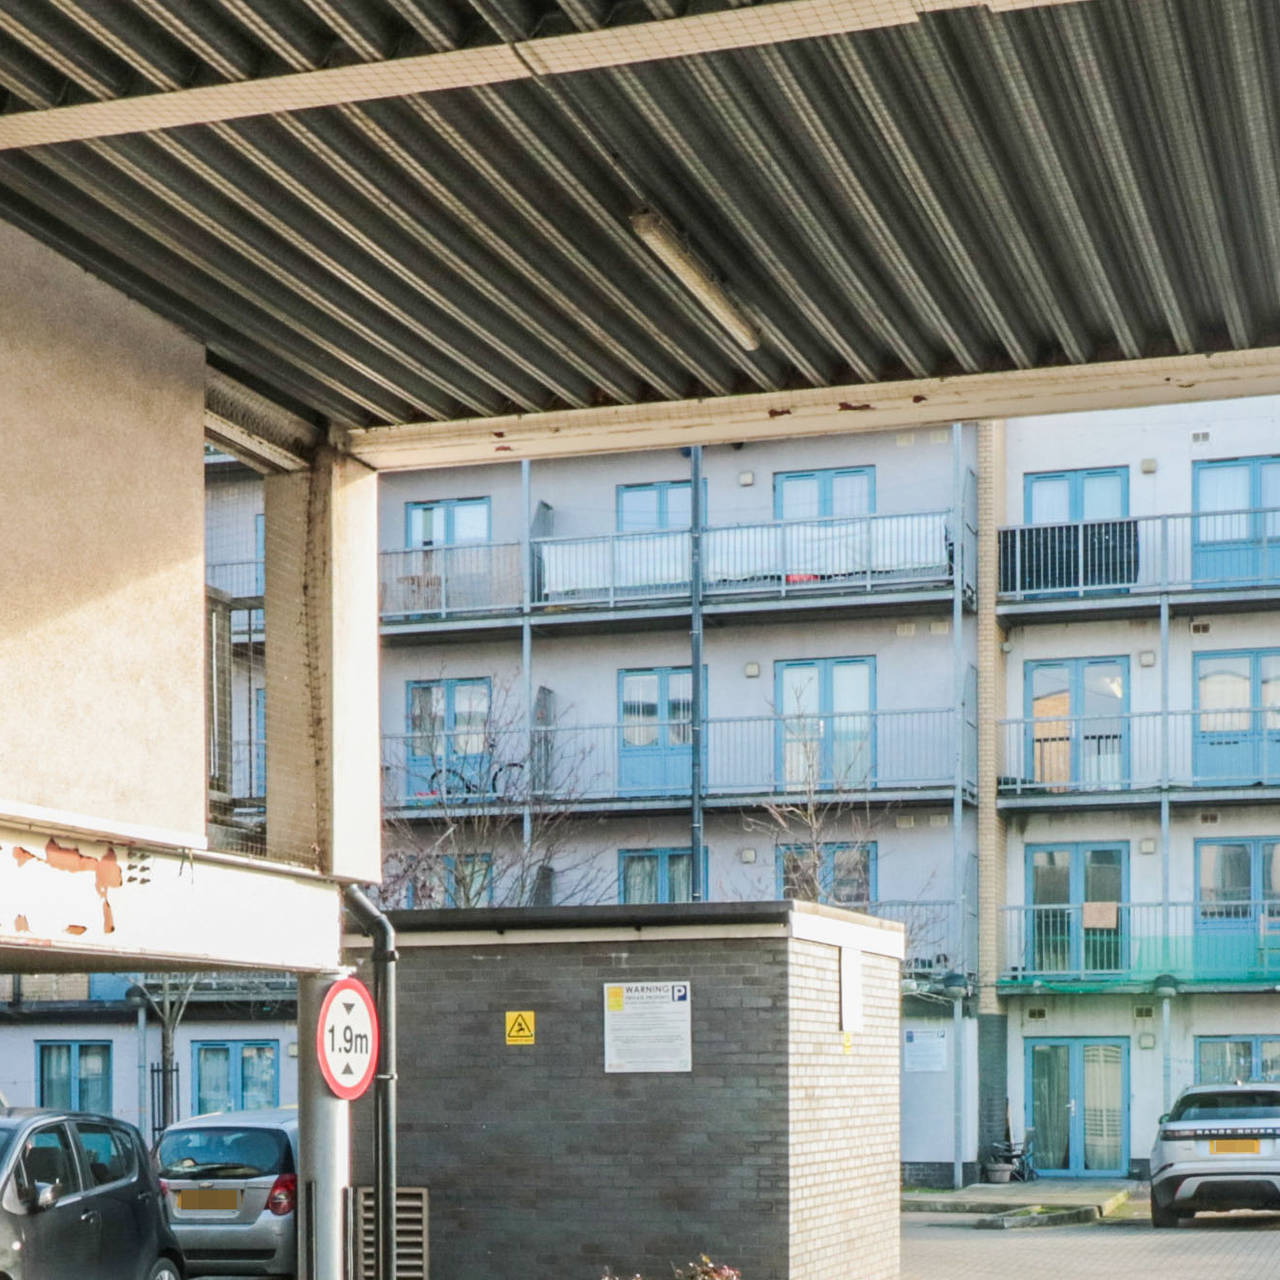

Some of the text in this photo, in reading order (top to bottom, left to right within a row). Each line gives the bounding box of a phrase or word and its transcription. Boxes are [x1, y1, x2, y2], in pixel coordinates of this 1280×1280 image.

[625, 985, 670, 993] WARNING
[674, 986, 685, 1001] P
[328, 1024, 368, 1054] 1.9m
